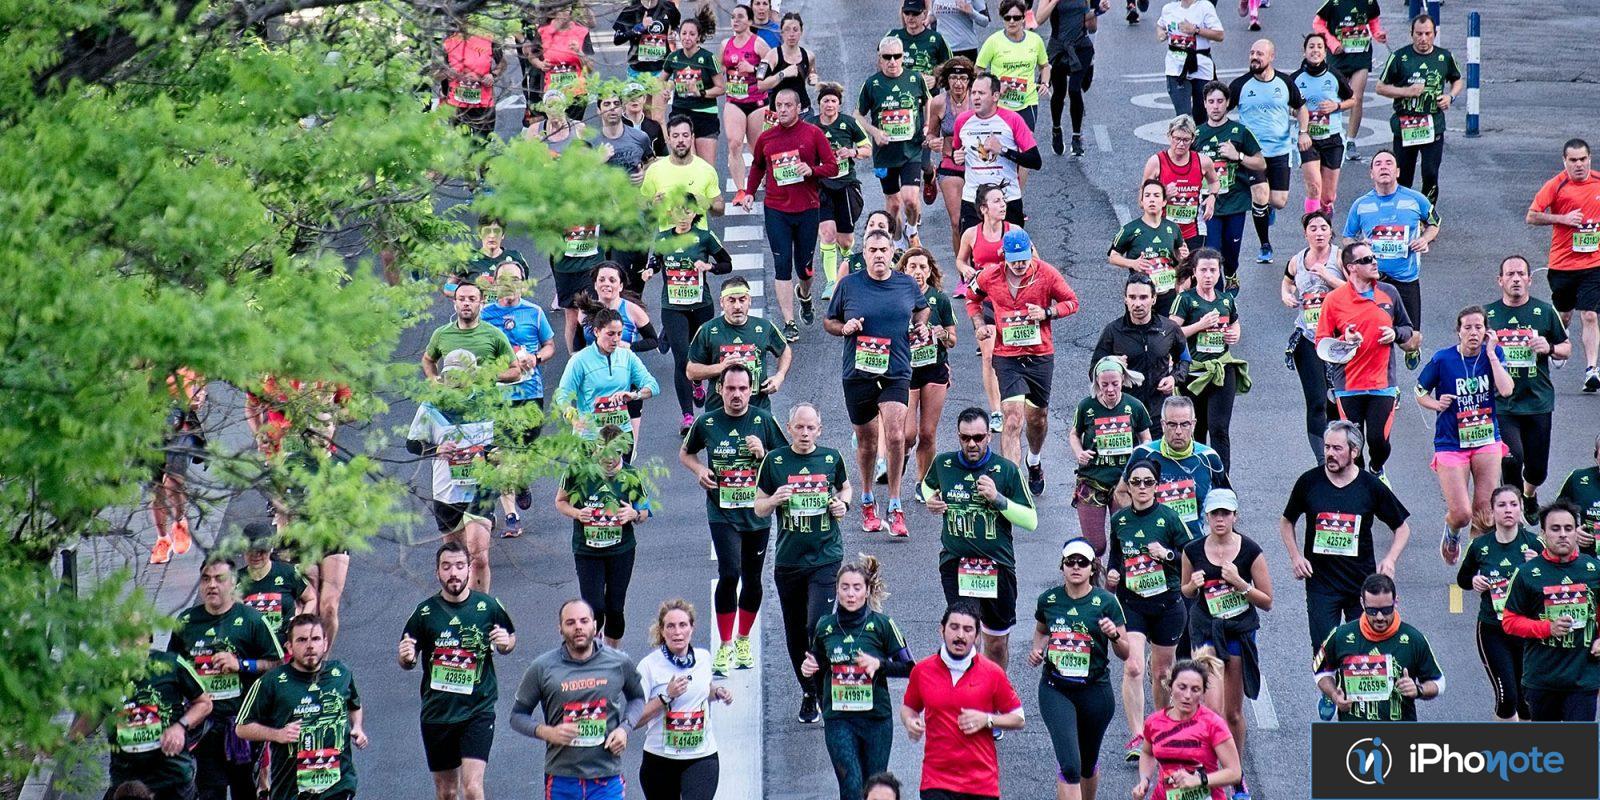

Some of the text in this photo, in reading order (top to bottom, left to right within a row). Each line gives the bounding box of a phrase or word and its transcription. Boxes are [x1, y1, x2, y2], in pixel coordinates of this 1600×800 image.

[1456, 391, 1489, 407] FOR THE
[731, 490, 751, 501] 42804
[946, 491, 970, 499] MADRID
[801, 497, 821, 508] 41756
[1327, 535, 1347, 547] 42572
[970, 579, 990, 589] 41644
[1050, 625, 1072, 633] MADRID
[434, 639, 460, 647] MADRID
[445, 672, 466, 684] 42859
[210, 679, 232, 690] 42384
[1358, 681, 1380, 692] 42659
[293, 706, 321, 715] MADRID
[133, 729, 155, 742] 40821
